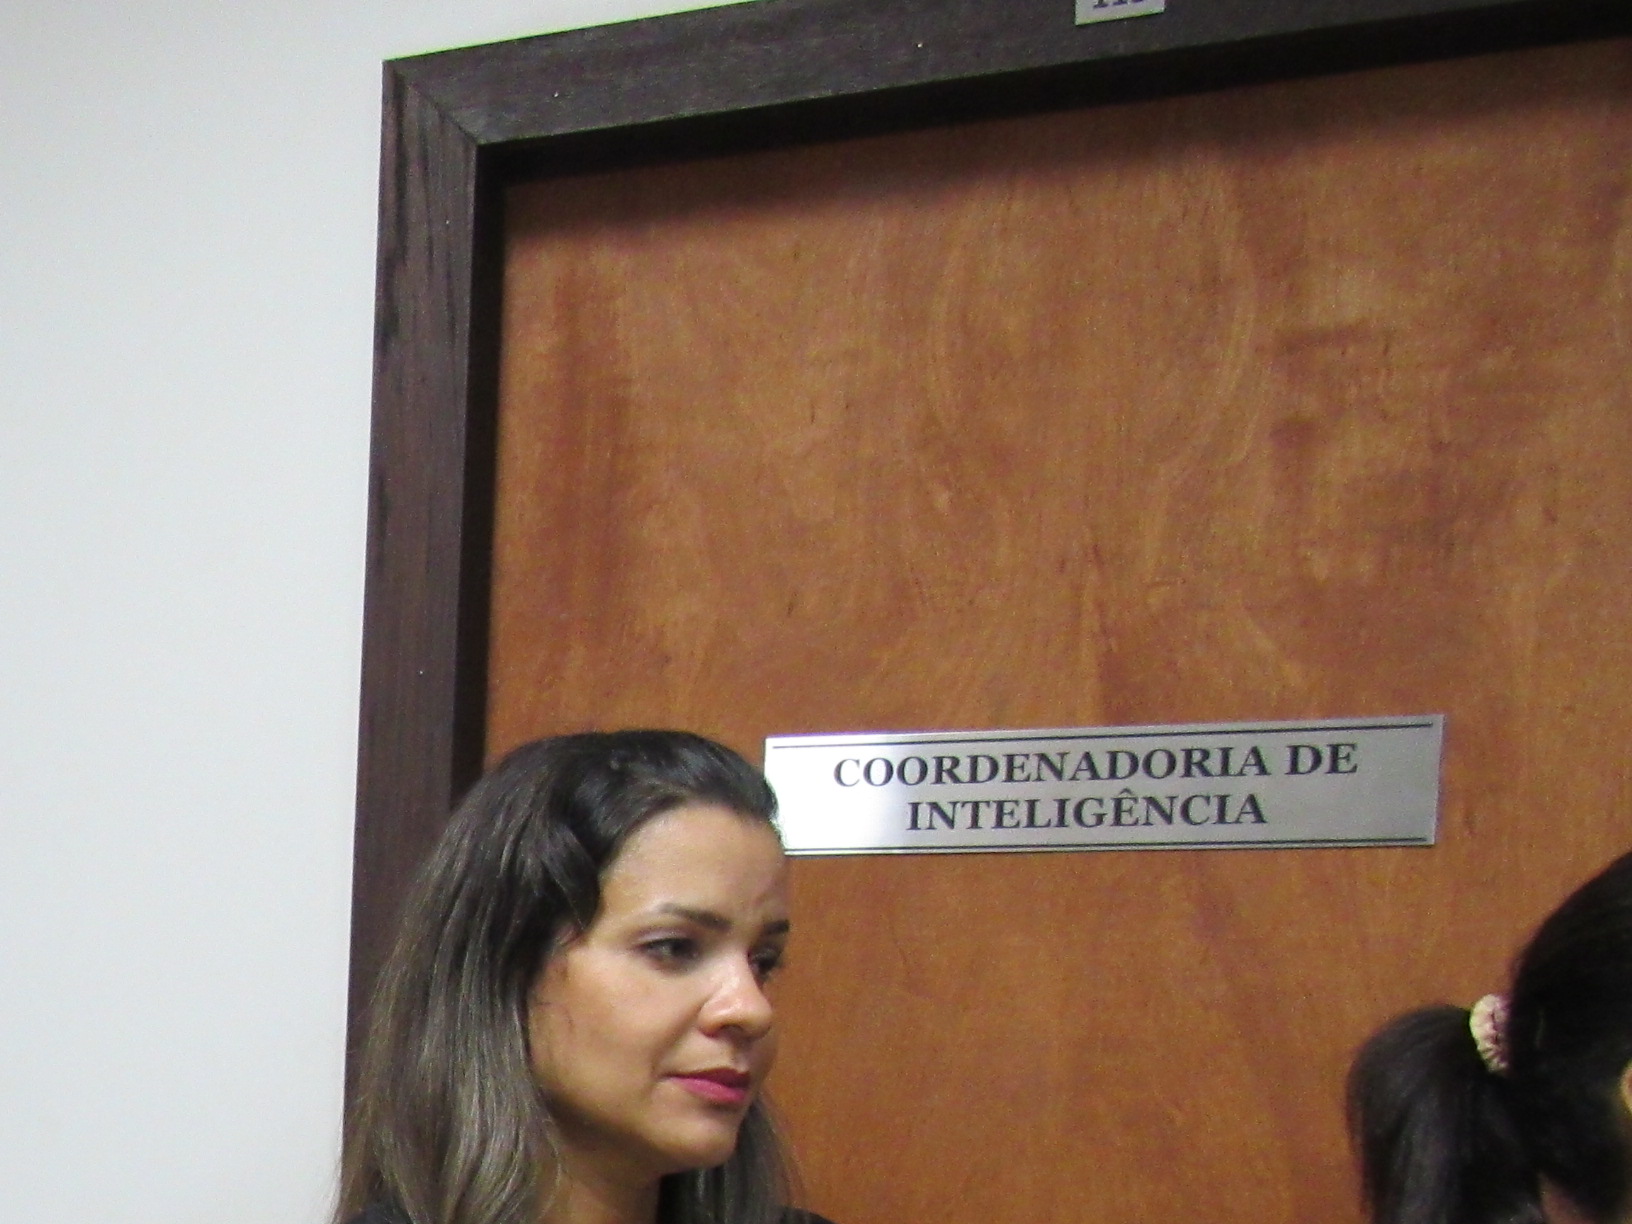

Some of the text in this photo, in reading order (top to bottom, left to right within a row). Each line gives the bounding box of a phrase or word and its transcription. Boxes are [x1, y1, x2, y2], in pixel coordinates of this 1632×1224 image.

[833, 742, 1359, 788] COORDENADORIA DE
[905, 788, 1268, 831] INTELIGÊNCIA
